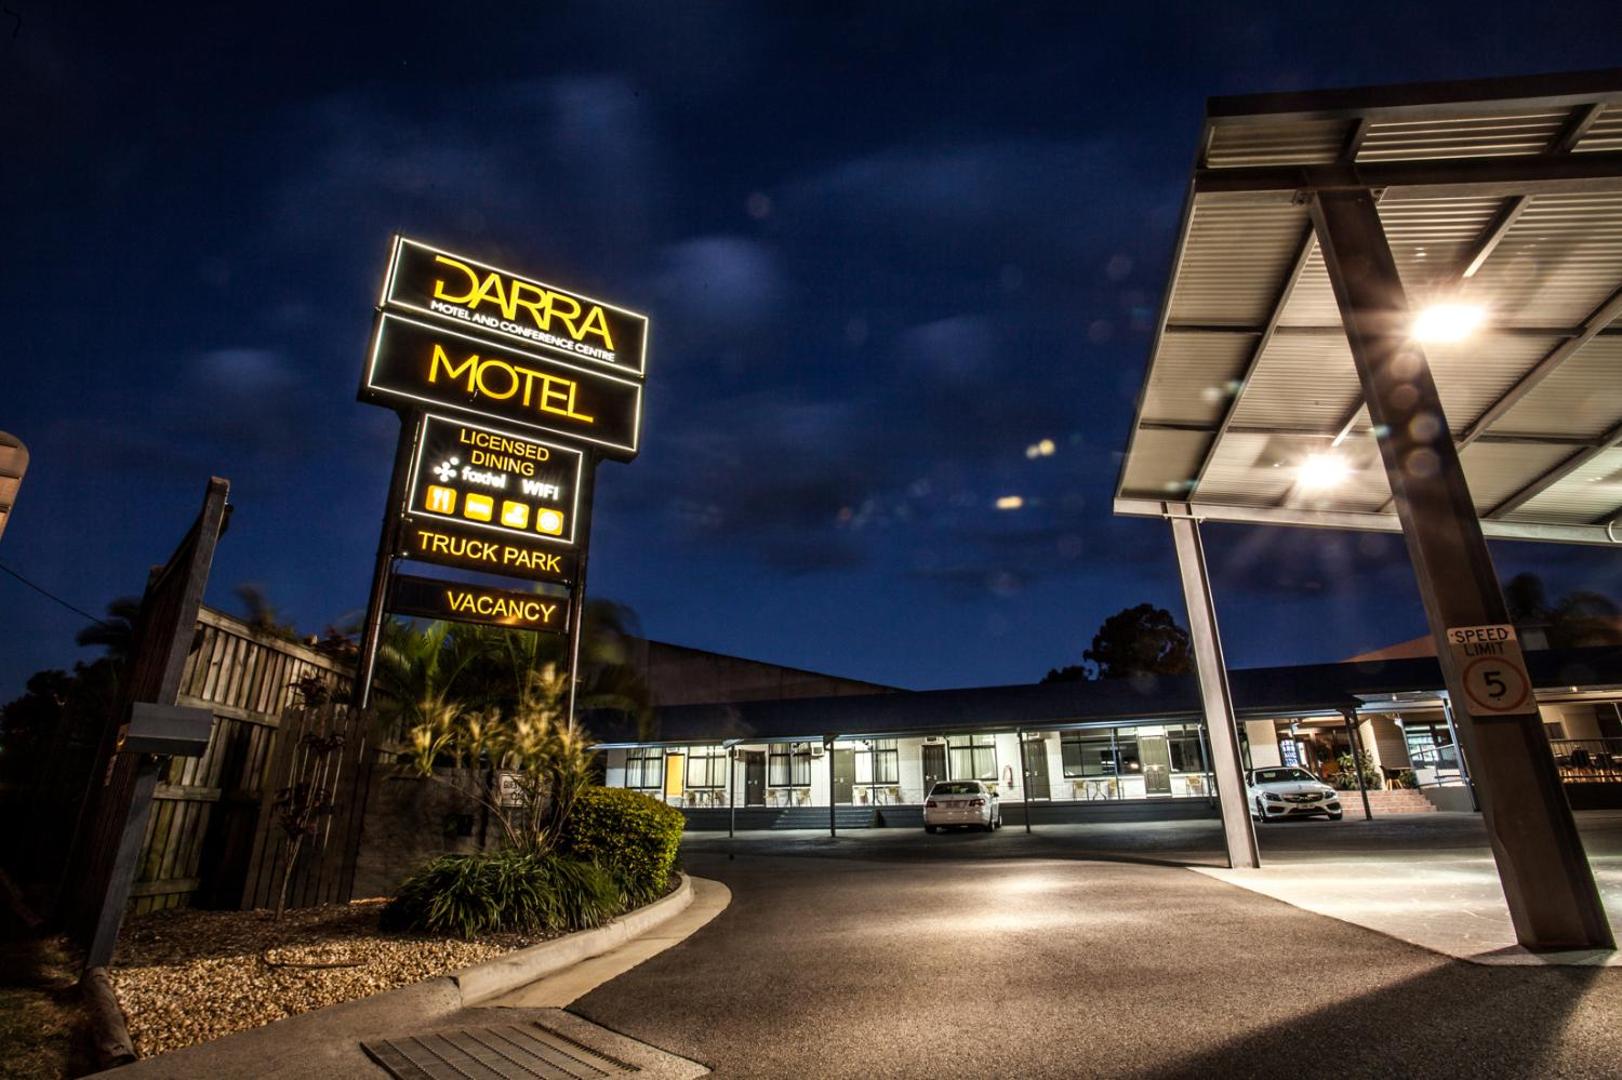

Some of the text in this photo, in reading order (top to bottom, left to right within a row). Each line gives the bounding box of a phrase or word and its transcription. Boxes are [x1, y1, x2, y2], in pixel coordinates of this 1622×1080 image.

[433, 254, 614, 350] DARRA
[430, 300, 616, 362] MOTEL AND CONFERENCE CENTRE
[428, 344, 594, 423] MOTEL
[460, 428, 549, 462] LICENSED
[471, 450, 535, 476] DINING
[418, 531, 561, 573] TRUCK PARK
[447, 591, 556, 623] VACANCY
[1455, 627, 1508, 644] SPEED
[1463, 641, 1505, 657] LIMIT
[1483, 671, 1507, 698] 5
